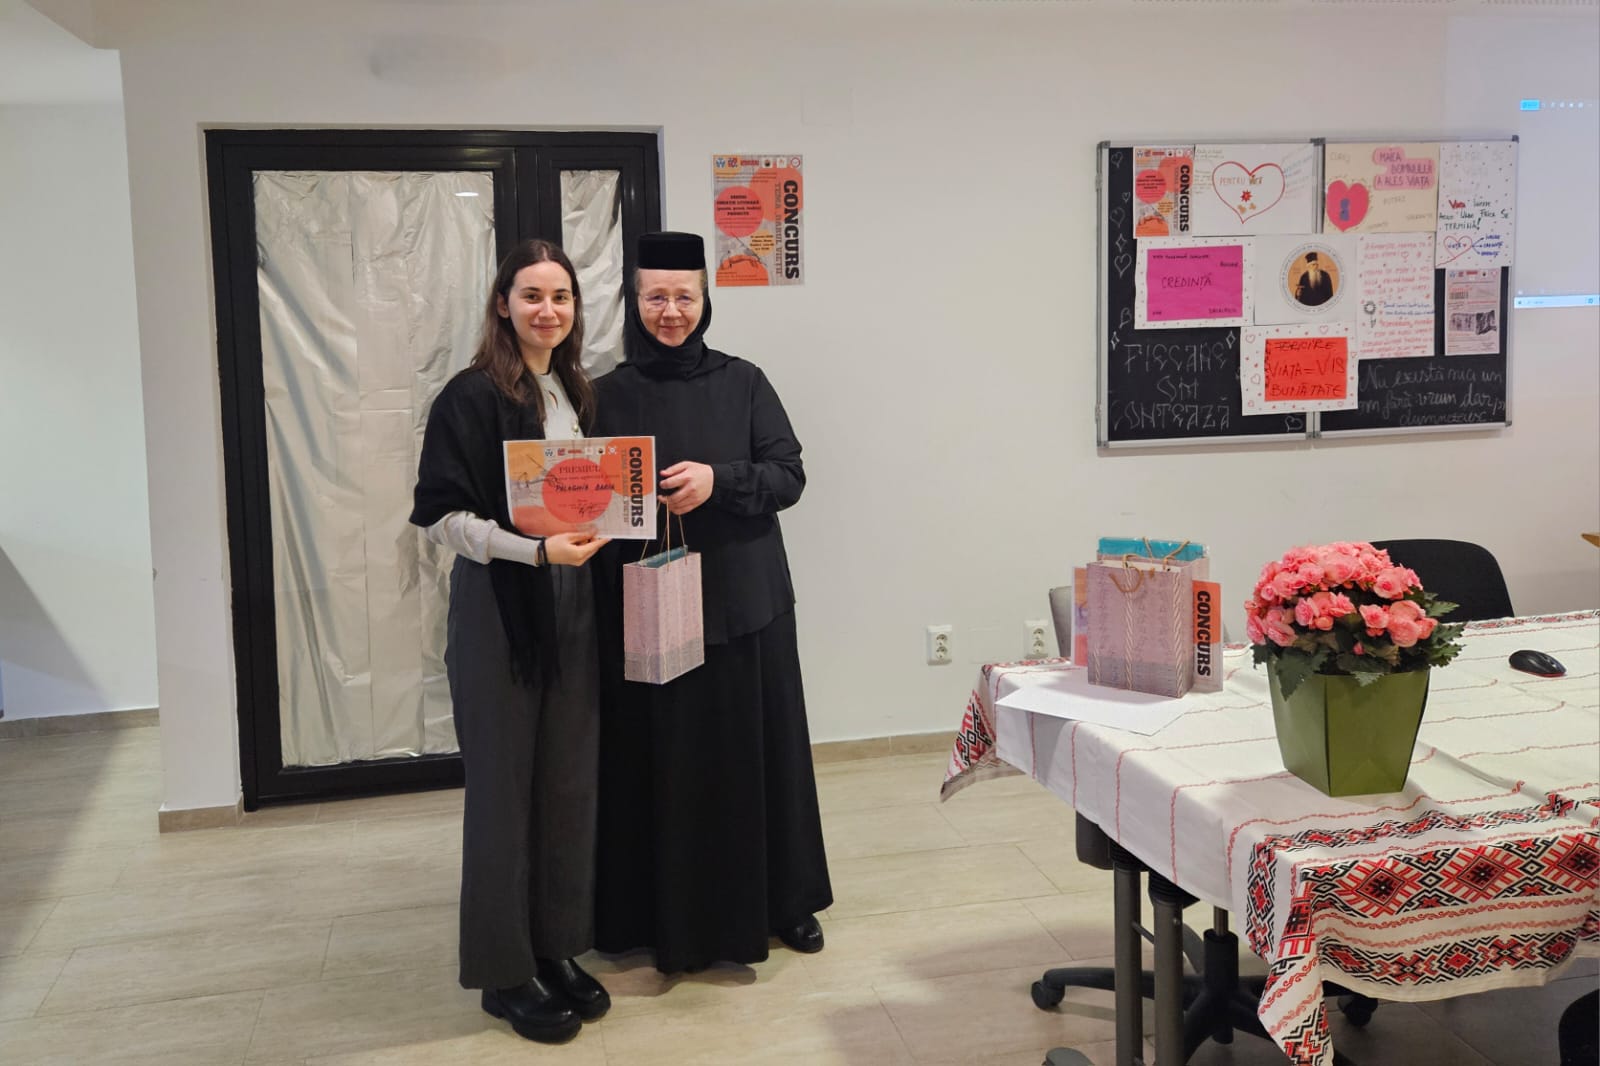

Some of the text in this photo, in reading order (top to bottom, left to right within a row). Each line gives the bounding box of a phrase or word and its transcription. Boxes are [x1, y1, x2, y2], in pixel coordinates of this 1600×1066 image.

[784, 180, 799, 279] CONCURS
[1180, 165, 1190, 232] CONCURS
[1360, 363, 1389, 391] Nu
[629, 447, 643, 527] CONCURS
[1197, 590, 1211, 677] CONCURS
